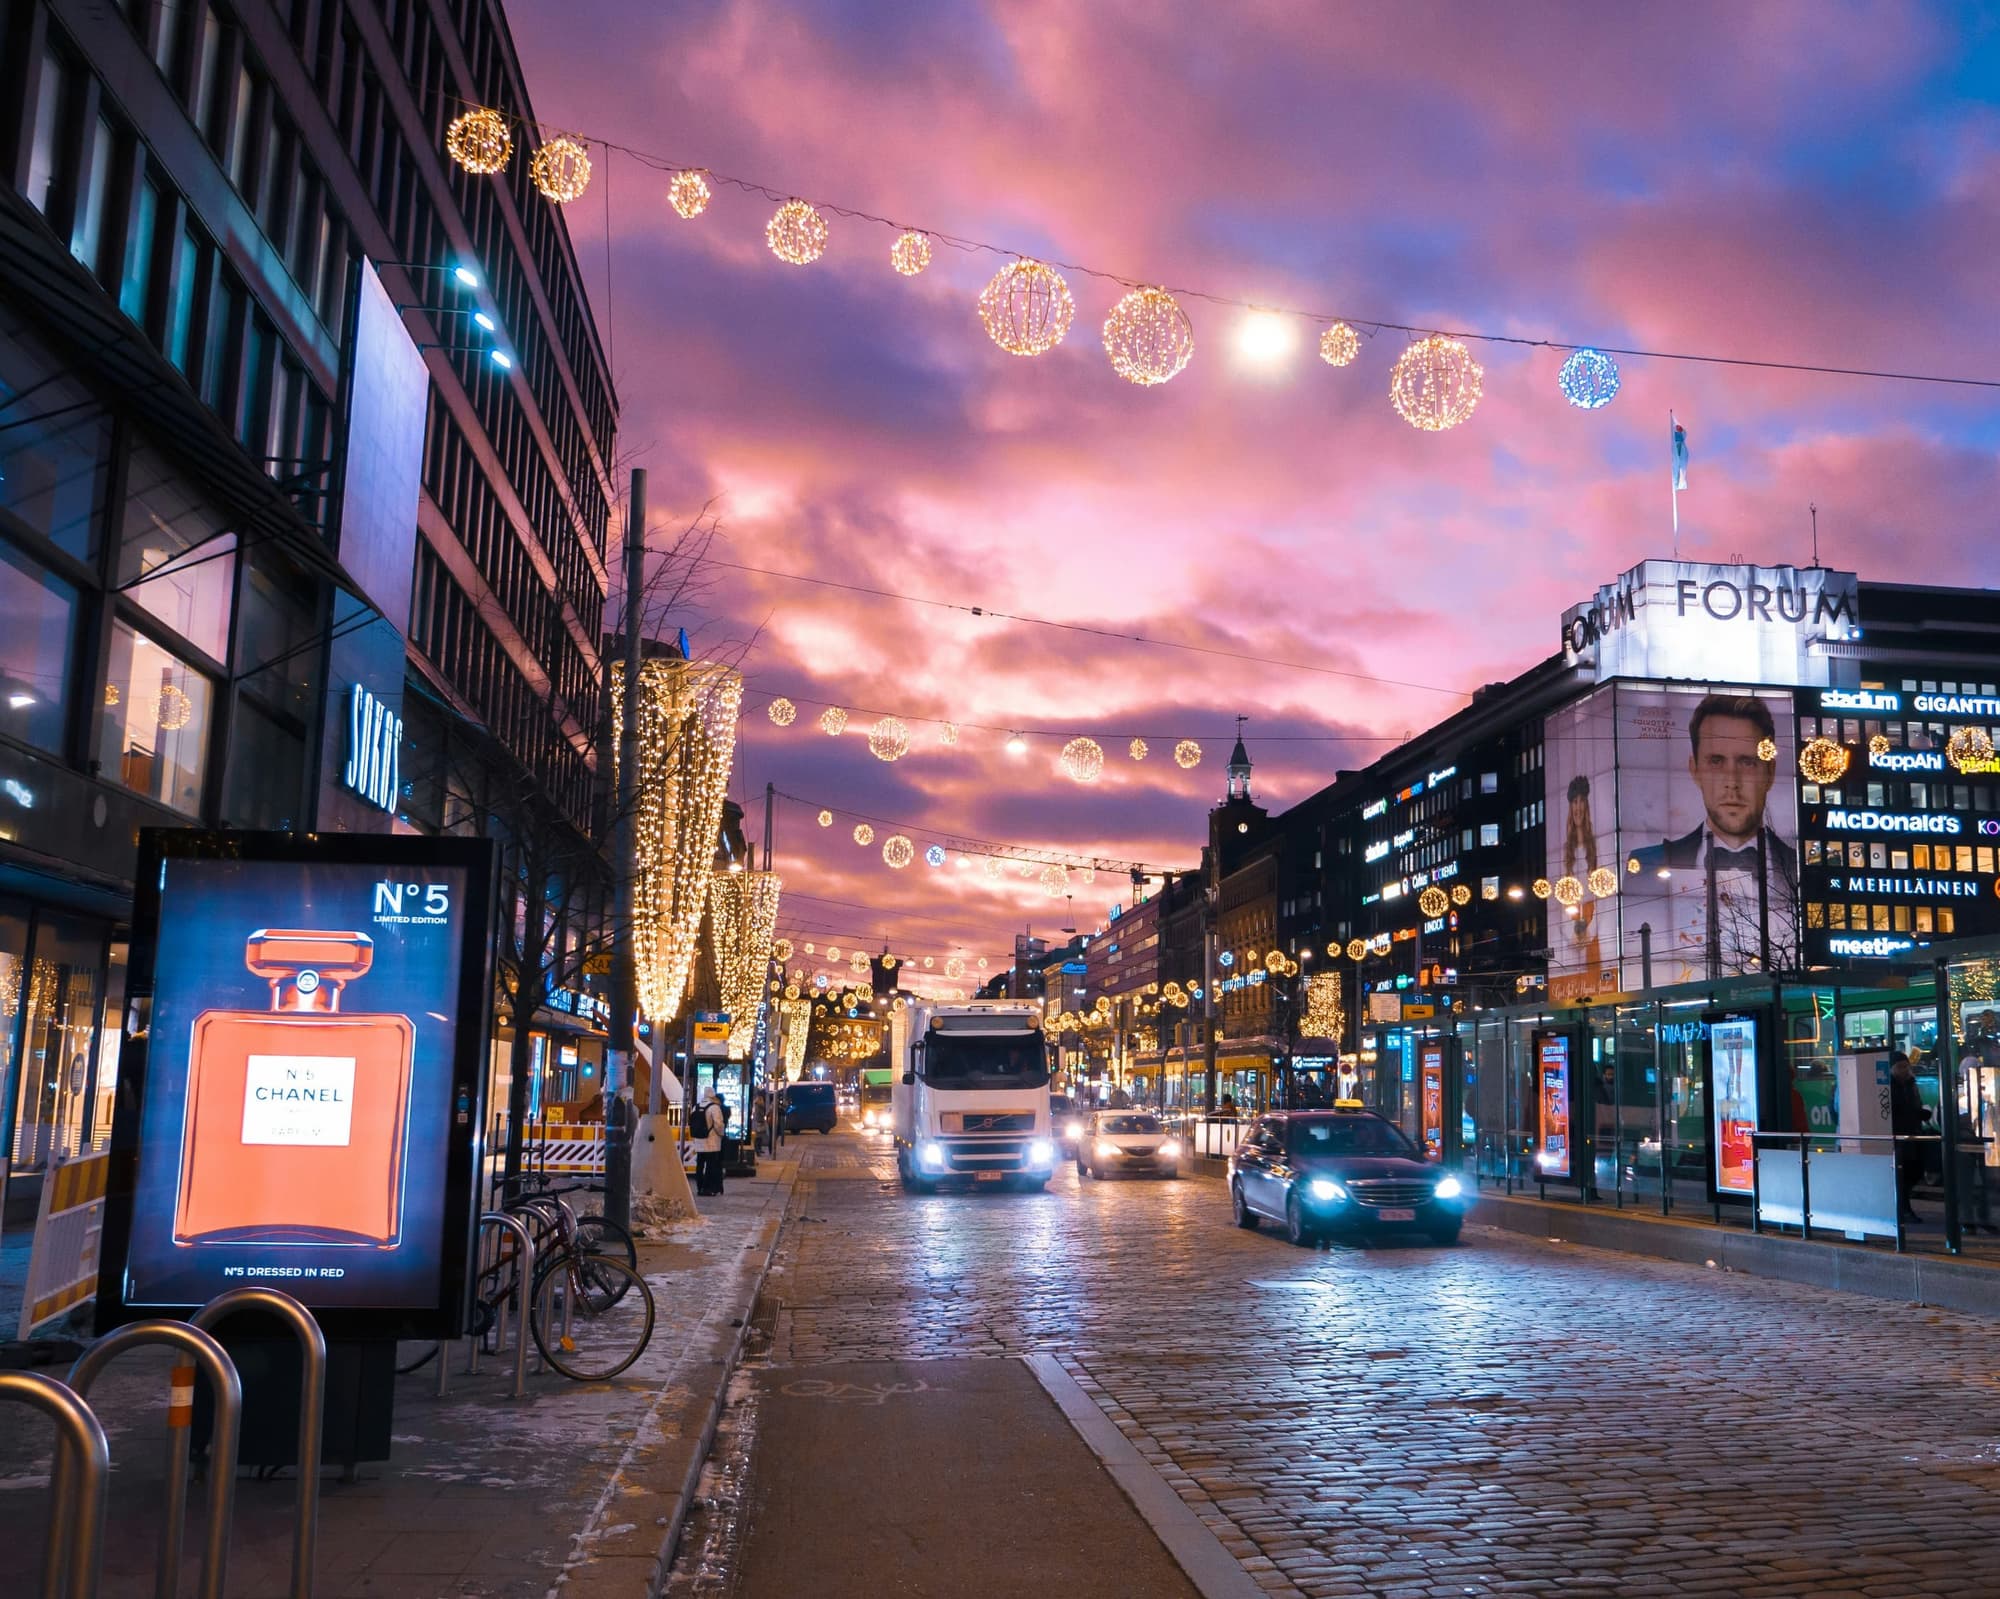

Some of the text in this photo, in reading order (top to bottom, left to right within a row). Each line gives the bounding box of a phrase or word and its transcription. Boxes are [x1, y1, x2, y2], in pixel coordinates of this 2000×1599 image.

[1676, 580, 1856, 625] FORUM
[1820, 689, 1899, 711] stadium
[348, 683, 403, 814] SOKOS
[1826, 811, 1961, 834] McDonald's
[1848, 877, 1978, 896] MEHILÄINEN
[373, 915, 448, 925] LIMITED EDITION
[255, 1086, 344, 1102] CHANEL
[247, 1267, 302, 1277] DRESSED
[304, 1268, 318, 1277] IN
[320, 1268, 345, 1278] RED
